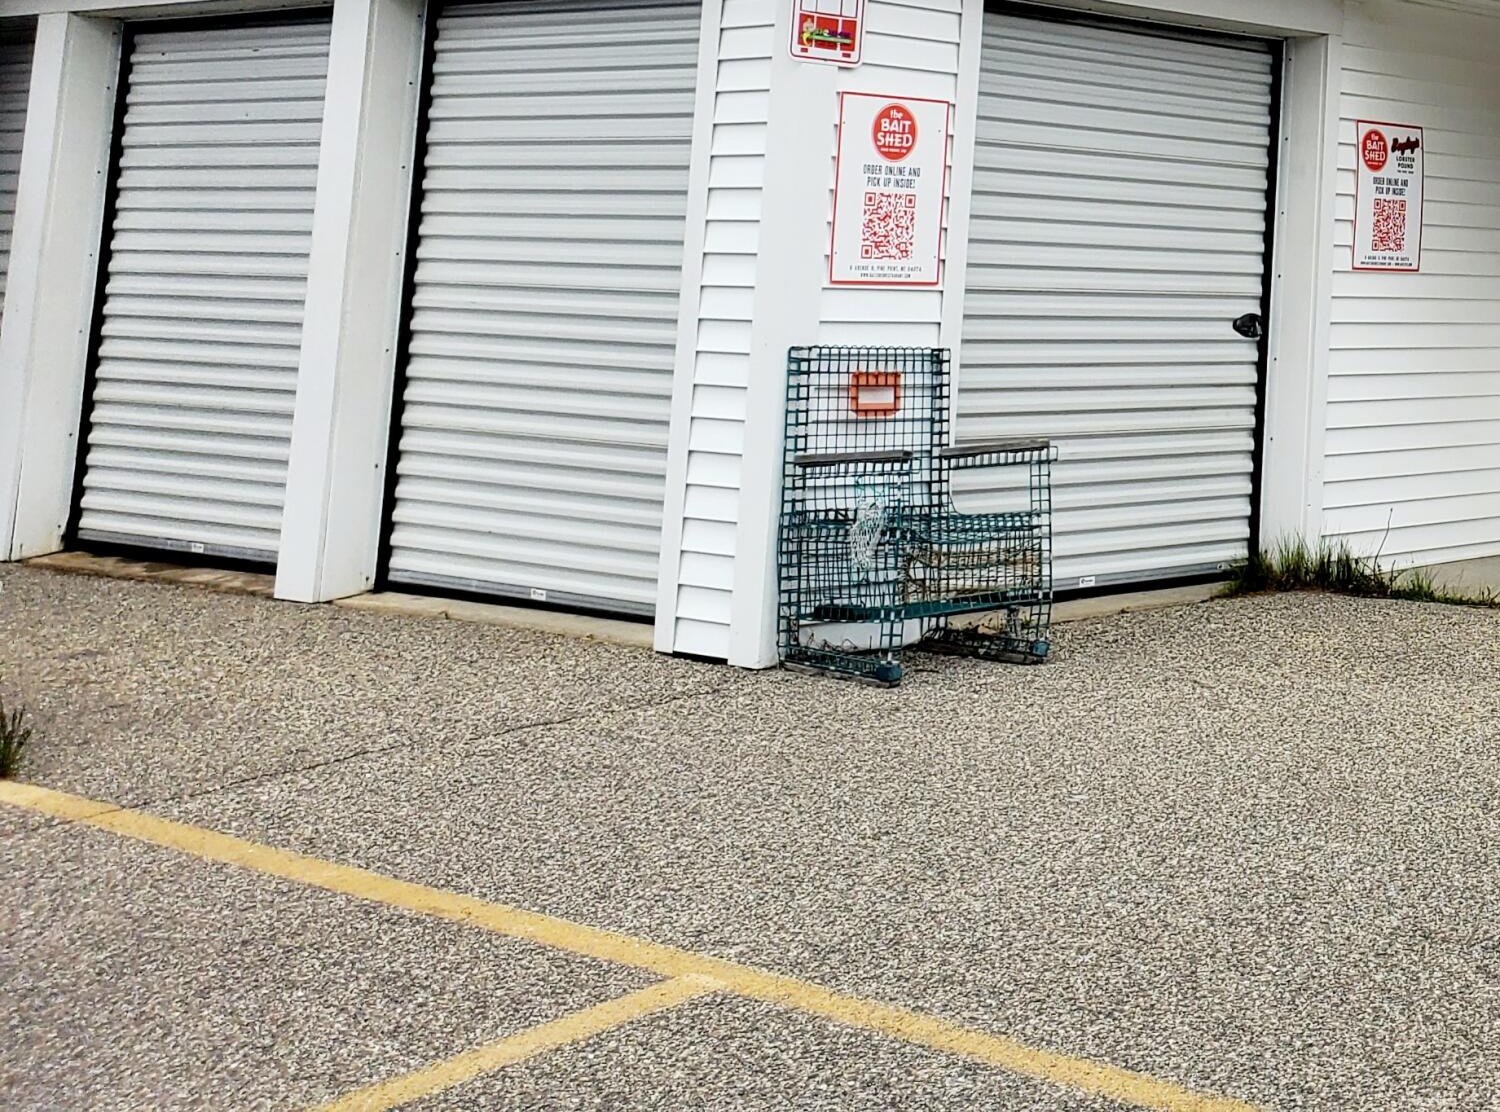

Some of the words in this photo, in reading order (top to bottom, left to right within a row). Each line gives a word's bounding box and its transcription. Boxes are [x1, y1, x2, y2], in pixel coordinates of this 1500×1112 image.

[880, 118, 911, 133] BAIT
[876, 132, 913, 148] SHED
[1366, 140, 1384, 150] BAIT
[1364, 150, 1386, 161] SHED
[863, 164, 882, 175] ORDER
[885, 165, 906, 176] ONLINE
[909, 167, 921, 177] AND
[866, 176, 881, 187] PICK
[884, 177, 892, 188] UP
